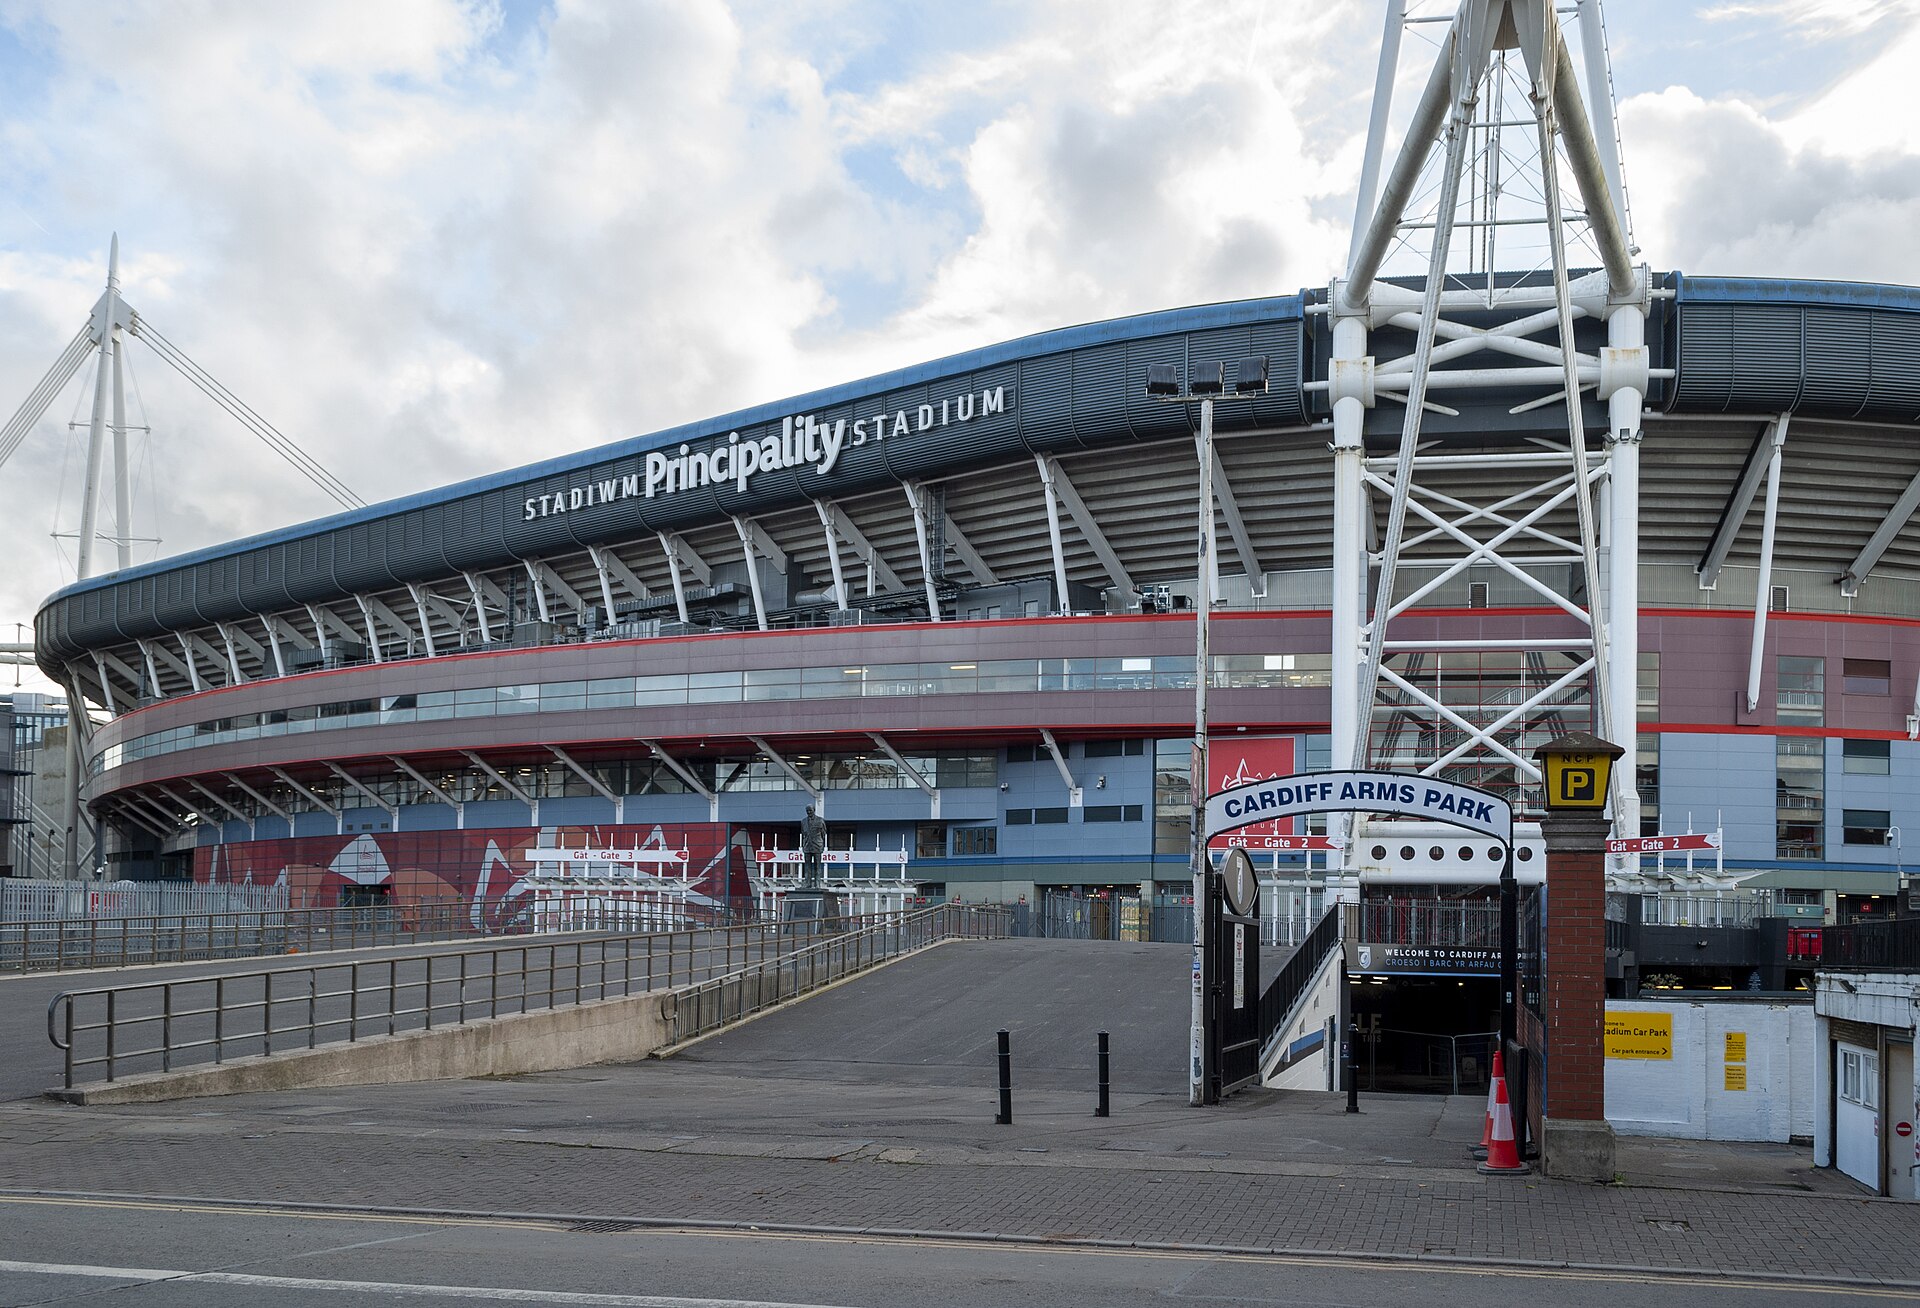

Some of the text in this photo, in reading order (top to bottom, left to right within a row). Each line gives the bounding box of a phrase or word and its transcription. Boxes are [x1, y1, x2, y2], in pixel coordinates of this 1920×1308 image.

[525, 386, 1004, 521] STADIWM Principality STADIUM
[1562, 754, 1594, 763] NCP
[1567, 771, 1589, 797] P
[1224, 781, 1496, 824] CARDIFF ARMS PARK
[1228, 836, 1248, 848] Gât
[1264, 837, 1291, 848] Gate
[1301, 837, 1309, 848] 2
[1610, 840, 1627, 852] Gât
[1641, 839, 1664, 851] Gate
[1672, 838, 1680, 849] 2
[600, 851, 620, 860] Gate
[628, 851, 633, 860] 3
[822, 852, 837, 861] ate
[844, 852, 850, 861] 3
[1385, 948, 1430, 957] WELCOME
[1449, 950, 1487, 959] CARDIFF
[1386, 958, 1420, 967] CROESO
[1429, 959, 1452, 967] BARC
[1455, 960, 1465, 968] YR
[1468, 960, 1495, 969] ARFAU
[1633, 1028, 1648, 1036] Car
[1649, 1028, 1668, 1037] Park
